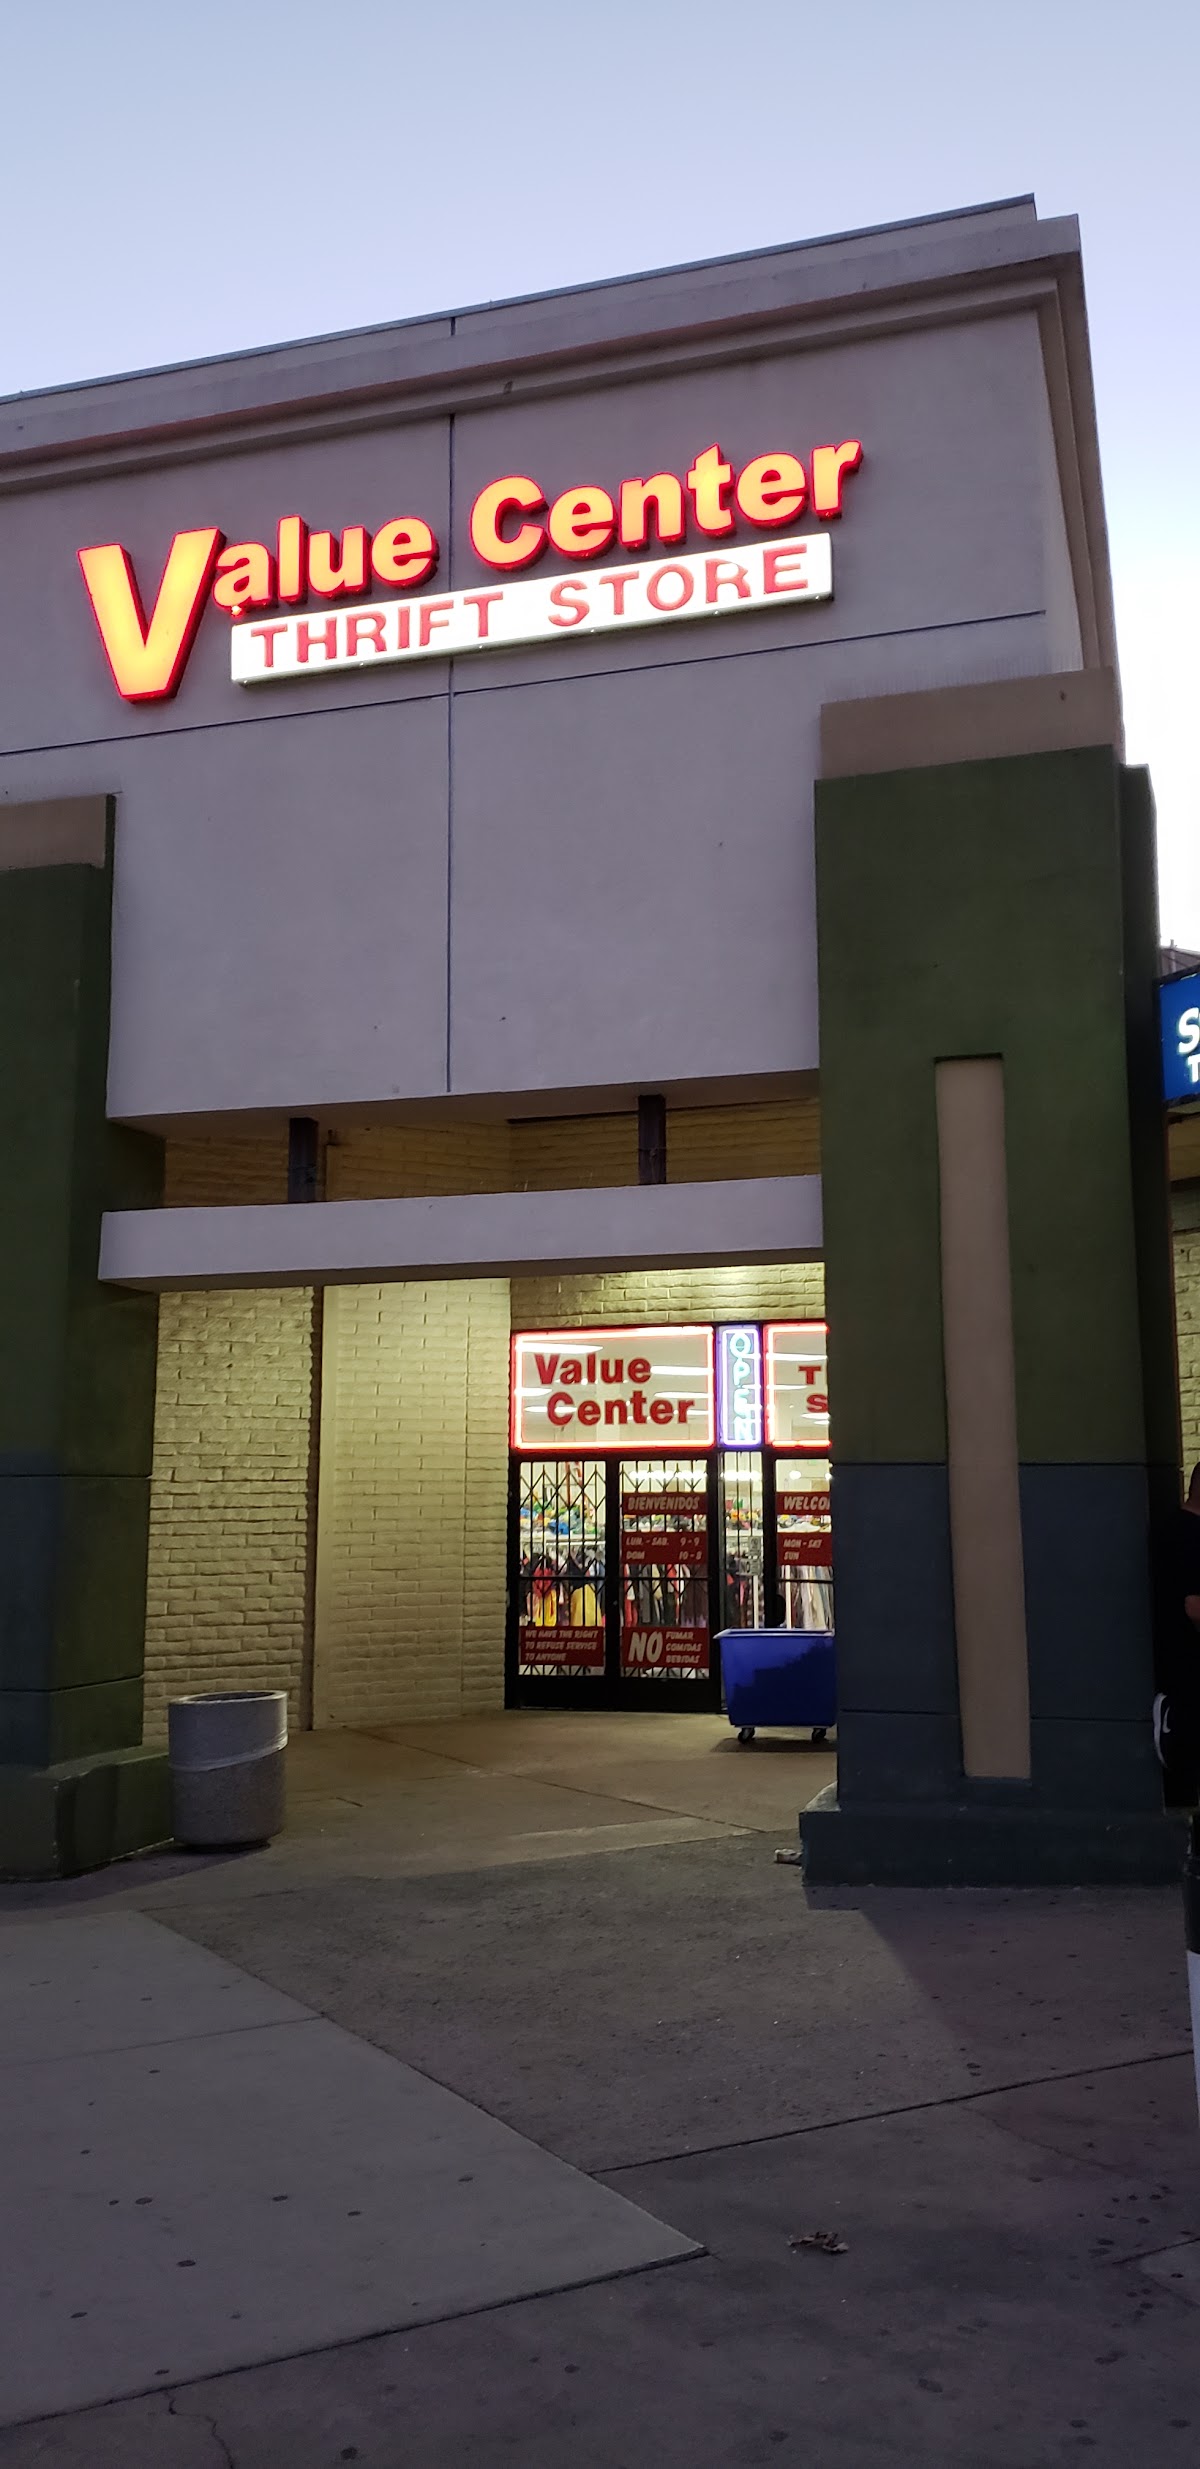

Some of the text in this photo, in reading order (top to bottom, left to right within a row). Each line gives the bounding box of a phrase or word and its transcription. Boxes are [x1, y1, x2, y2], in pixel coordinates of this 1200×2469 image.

[78, 440, 863, 703] Value Center
[251, 544, 808, 669] THRIFT STORE
[1178, 1007, 1200, 1054] S
[534, 1353, 651, 1384] Value
[729, 1332, 752, 1441] OPEN
[547, 1390, 695, 1426] Center
[627, 1496, 700, 1510] BIENVENIDOS
[783, 1496, 831, 1510] WELCO
[784, 1551, 800, 1560] SUN
[525, 1630, 598, 1639] WE HAVE THE RIGHT
[665, 1631, 694, 1640] FUMAR
[525, 1641, 597, 1650] TO REFUSE SERVICE
[628, 1631, 664, 1663] NO
[665, 1643, 702, 1652] COMIDAS
[525, 1653, 567, 1661] TO ANYONE
[665, 1655, 700, 1664] BEBIDAS
